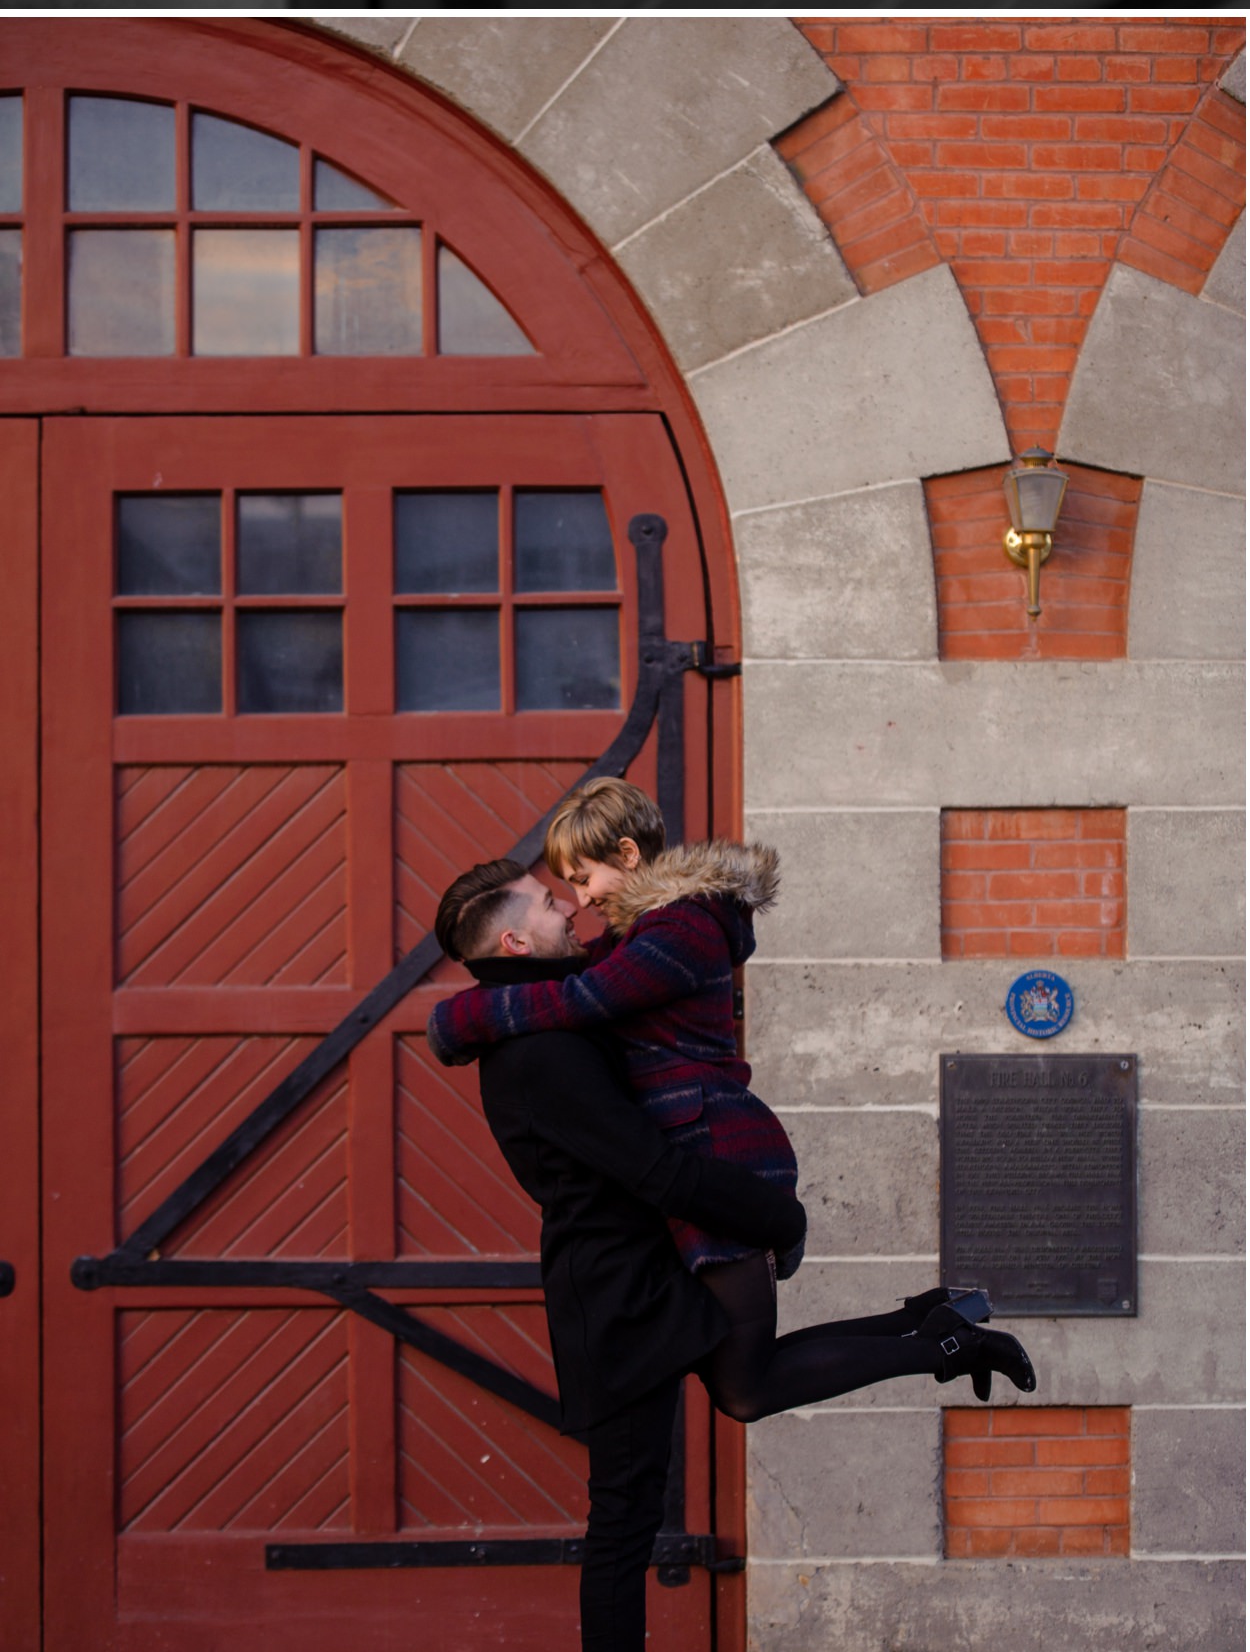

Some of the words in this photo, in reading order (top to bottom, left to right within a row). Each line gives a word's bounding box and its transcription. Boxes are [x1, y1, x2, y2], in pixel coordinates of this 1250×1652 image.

[991, 1072, 1017, 1088] FIRE
[1023, 1072, 1056, 1088] HALL
[1077, 1071, 1088, 1087] 6
